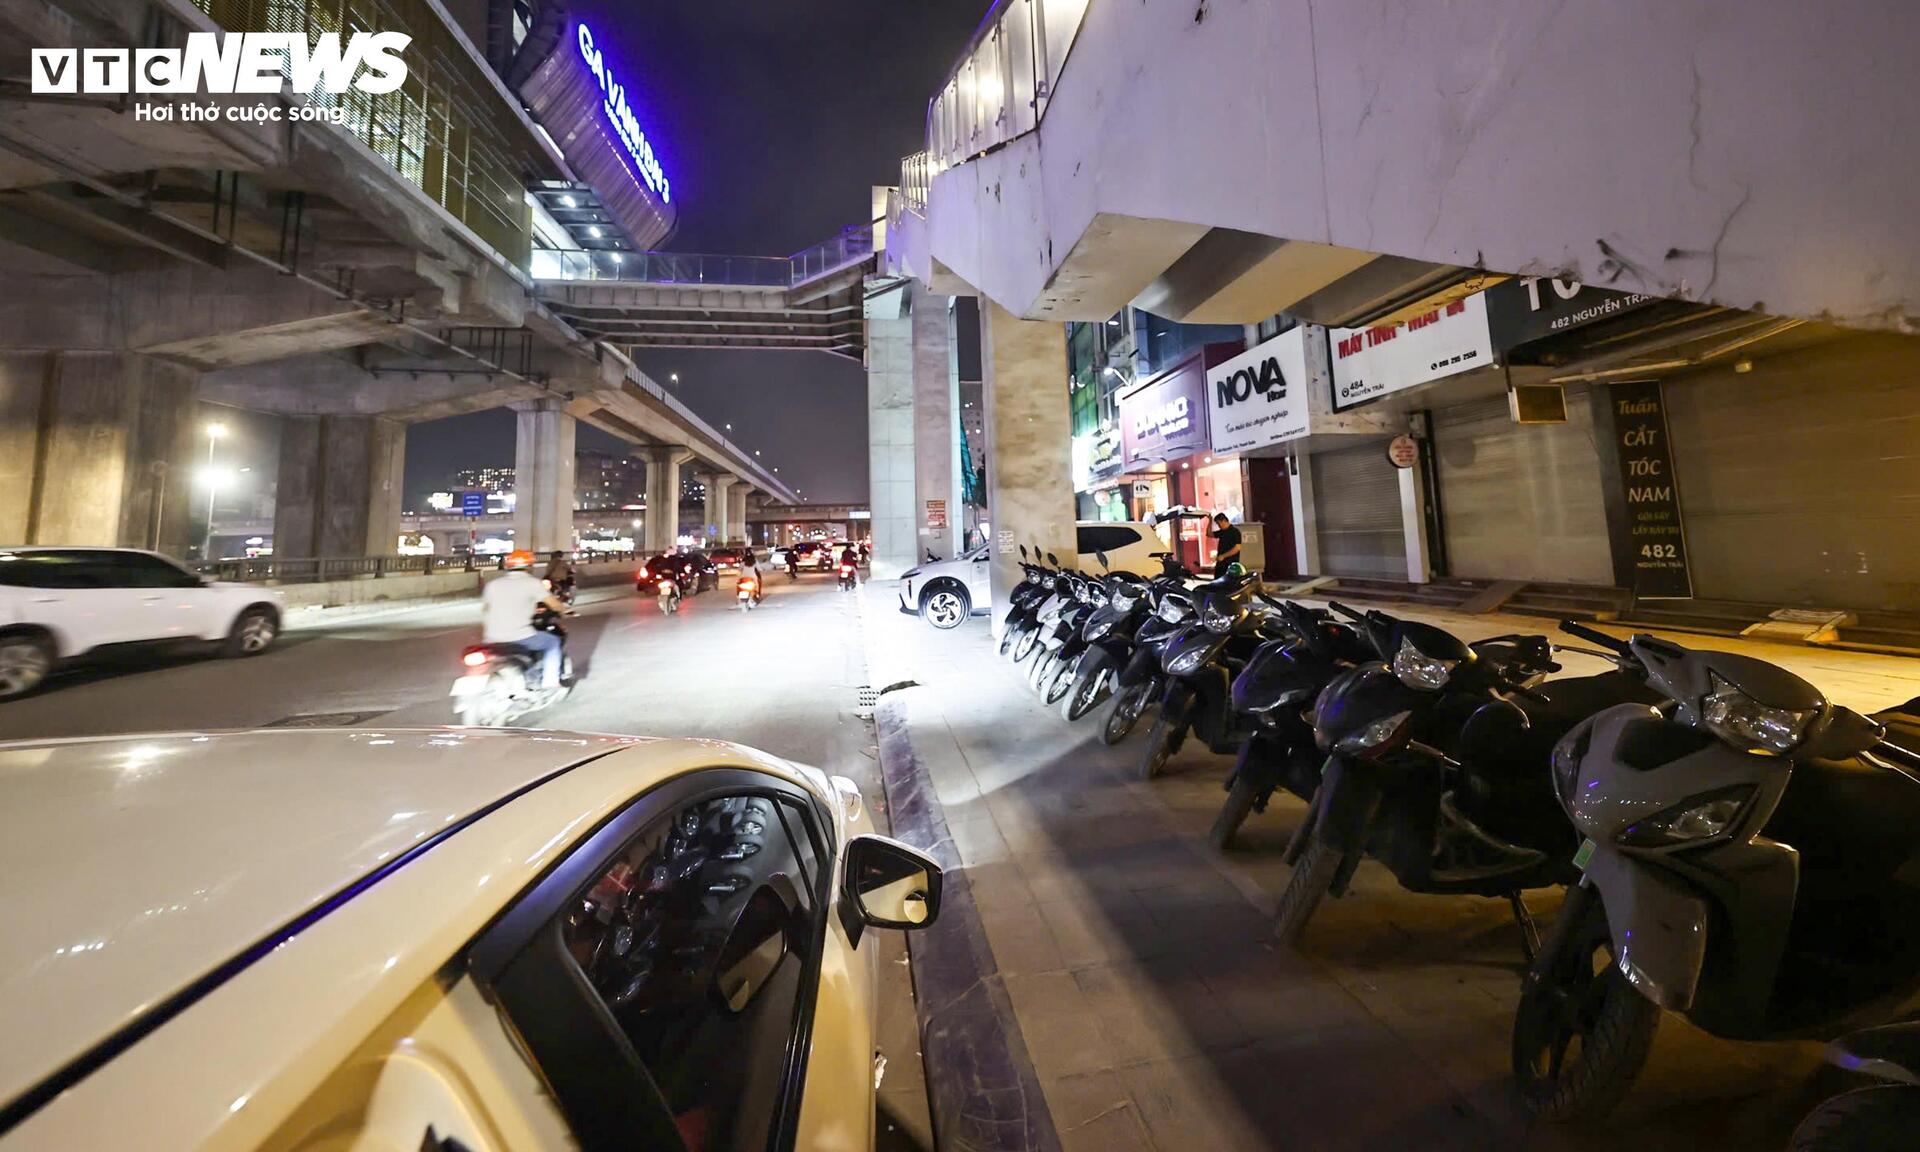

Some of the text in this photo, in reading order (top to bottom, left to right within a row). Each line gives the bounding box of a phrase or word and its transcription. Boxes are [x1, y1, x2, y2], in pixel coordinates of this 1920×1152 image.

[578, 24, 605, 90] GA
[662, 178, 670, 204] 3
[1551, 316, 1569, 330] 482
[1572, 299, 1620, 324] NGUYỄN
[1338, 333, 1363, 360] MÁY
[1217, 356, 1286, 408] NOVA
[1350, 380, 1364, 391] 484
[1628, 457, 1662, 475] TÓC
[1628, 486, 1671, 503] NAM
[1641, 544, 1677, 558] 482
